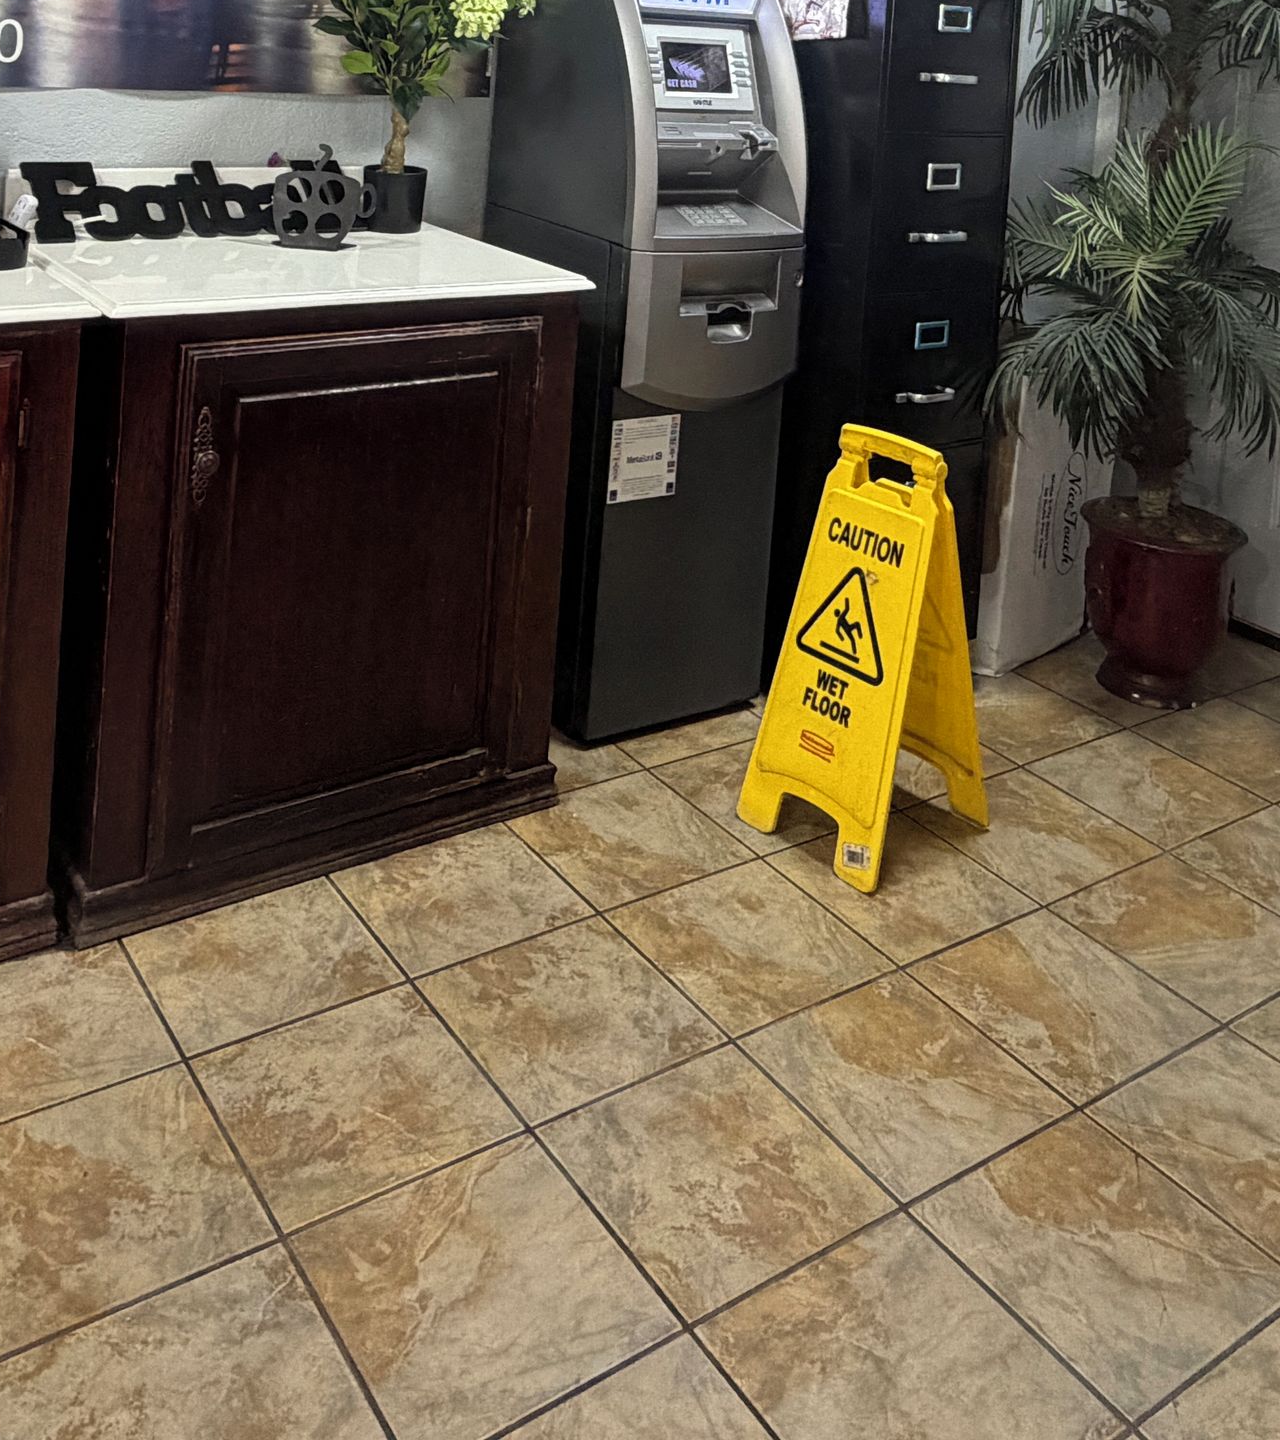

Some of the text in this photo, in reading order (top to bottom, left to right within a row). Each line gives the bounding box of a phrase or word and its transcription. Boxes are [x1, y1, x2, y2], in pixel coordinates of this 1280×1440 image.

[828, 517, 905, 569] CAUTION
[817, 669, 849, 700] WET
[802, 686, 851, 728] FLOOR
